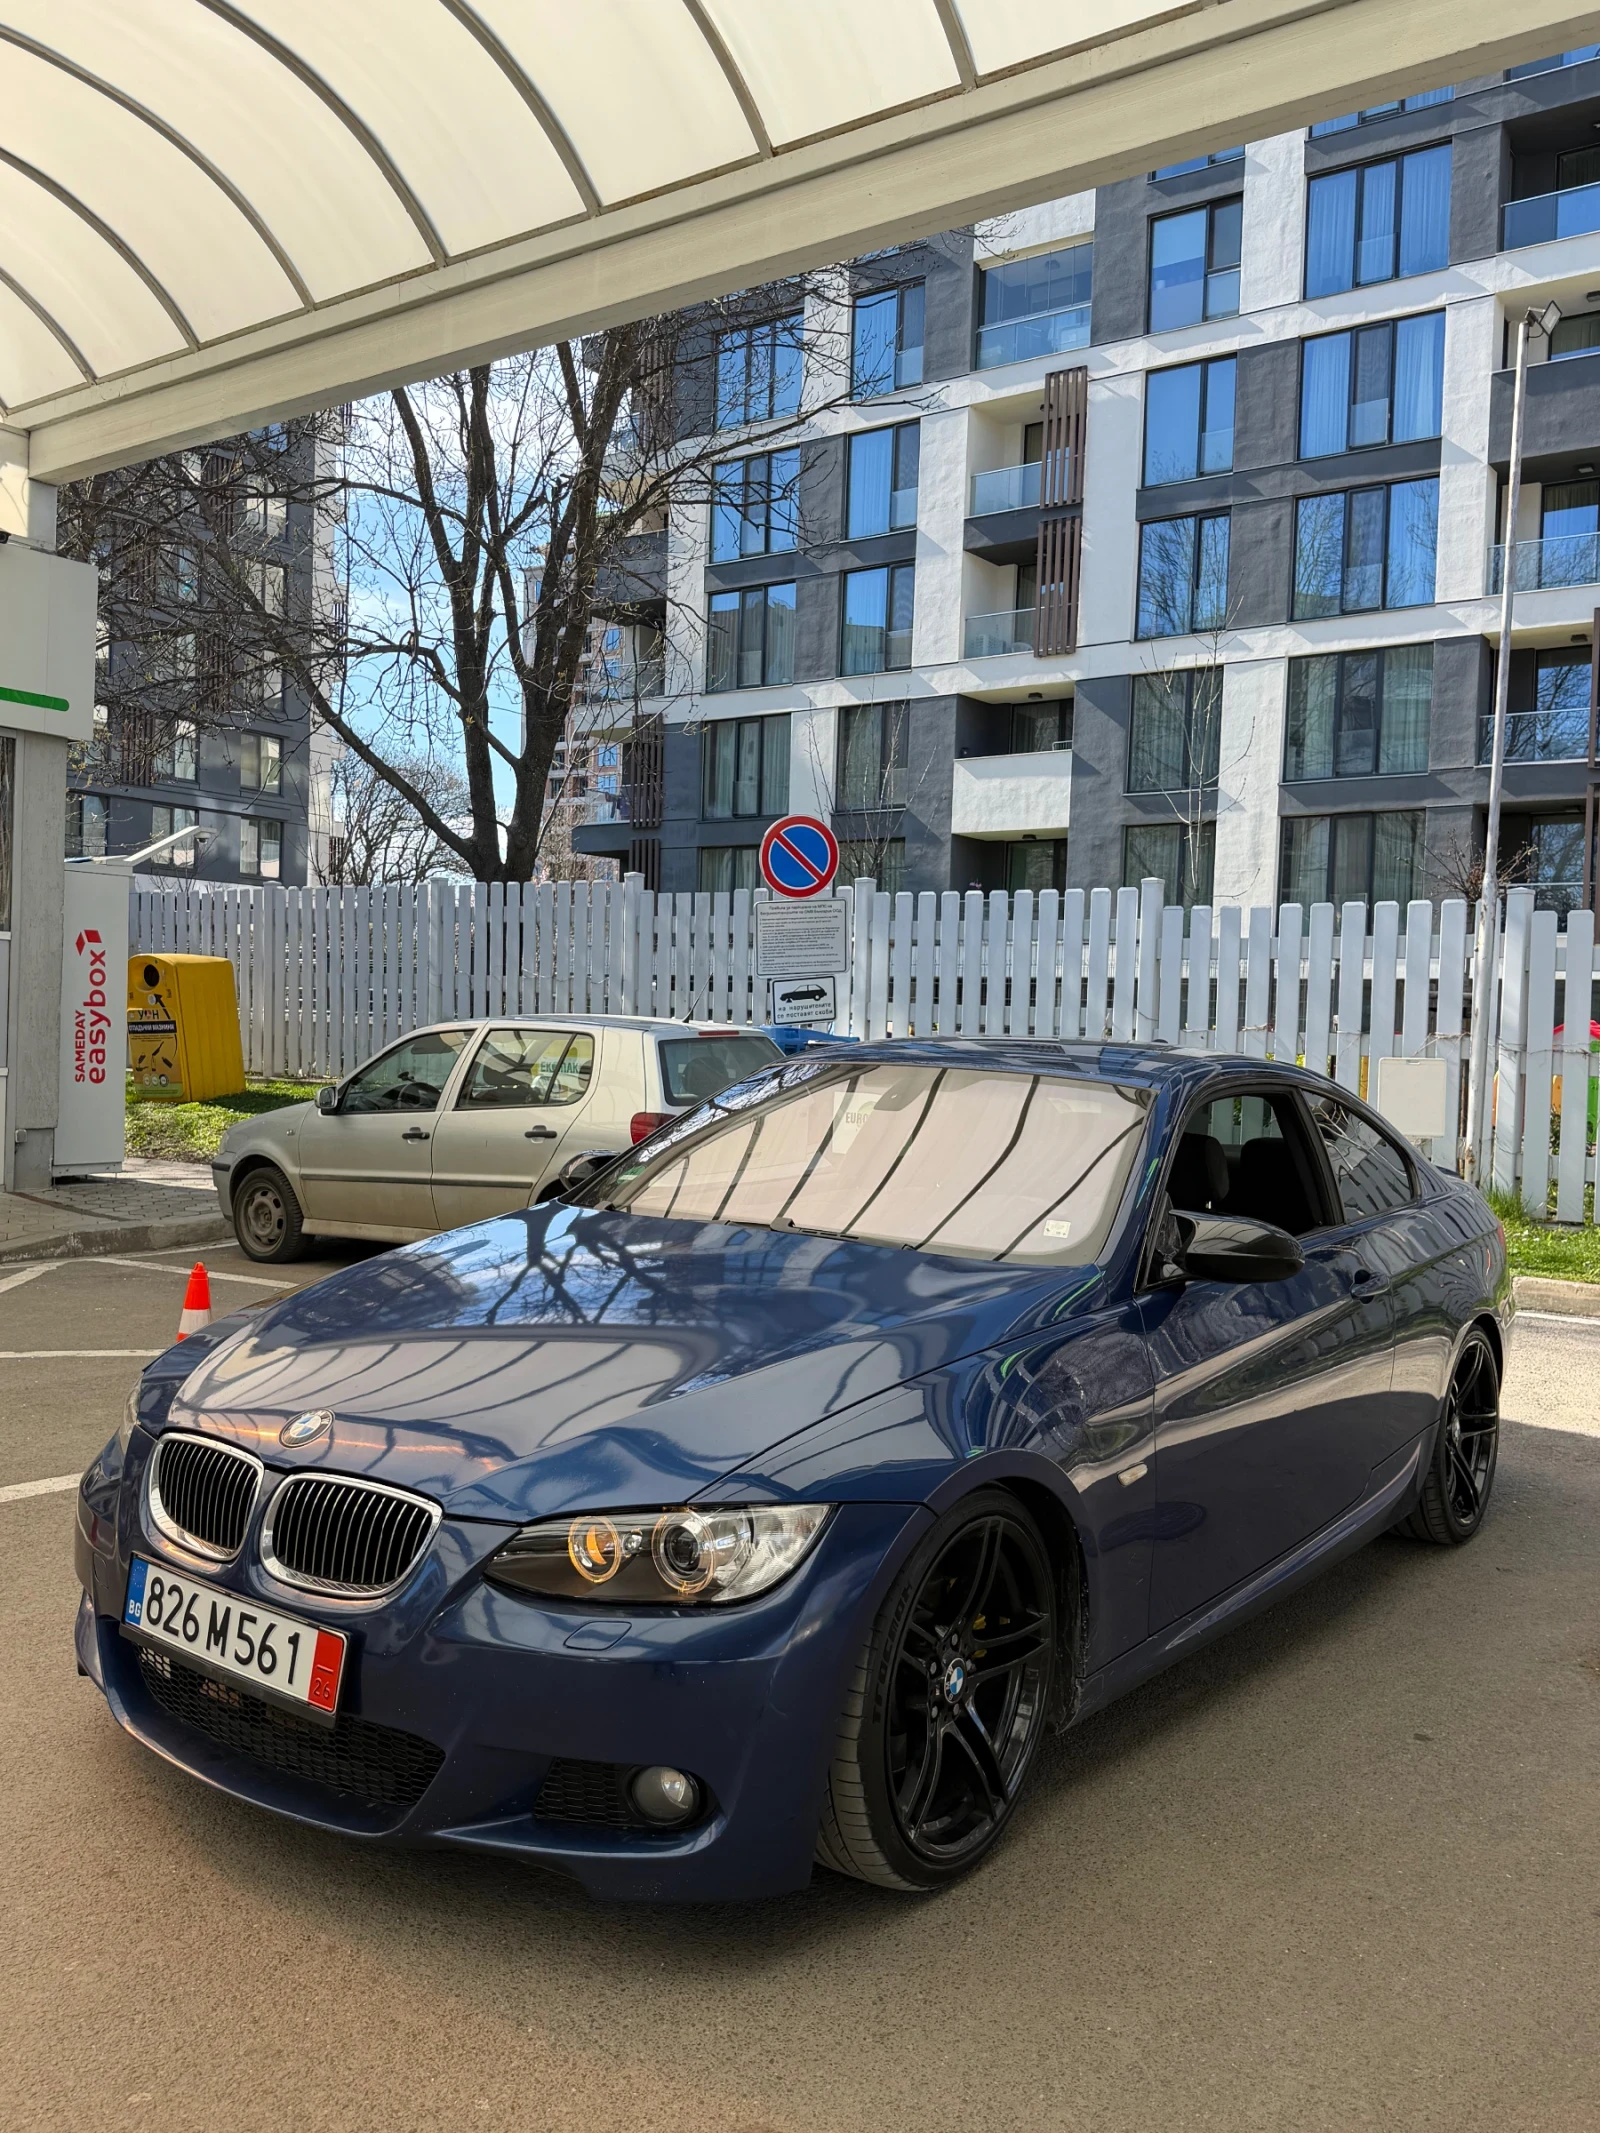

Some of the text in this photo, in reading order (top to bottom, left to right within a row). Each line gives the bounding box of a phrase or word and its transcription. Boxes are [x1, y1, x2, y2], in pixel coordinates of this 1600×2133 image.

[75, 1010, 86, 1083] SAMEDAY
[83, 949, 112, 1084] easybox
[815, 1008, 833, 1016] скоби
[128, 1599, 142, 1617] BG
[313, 1677, 331, 1699] 26
